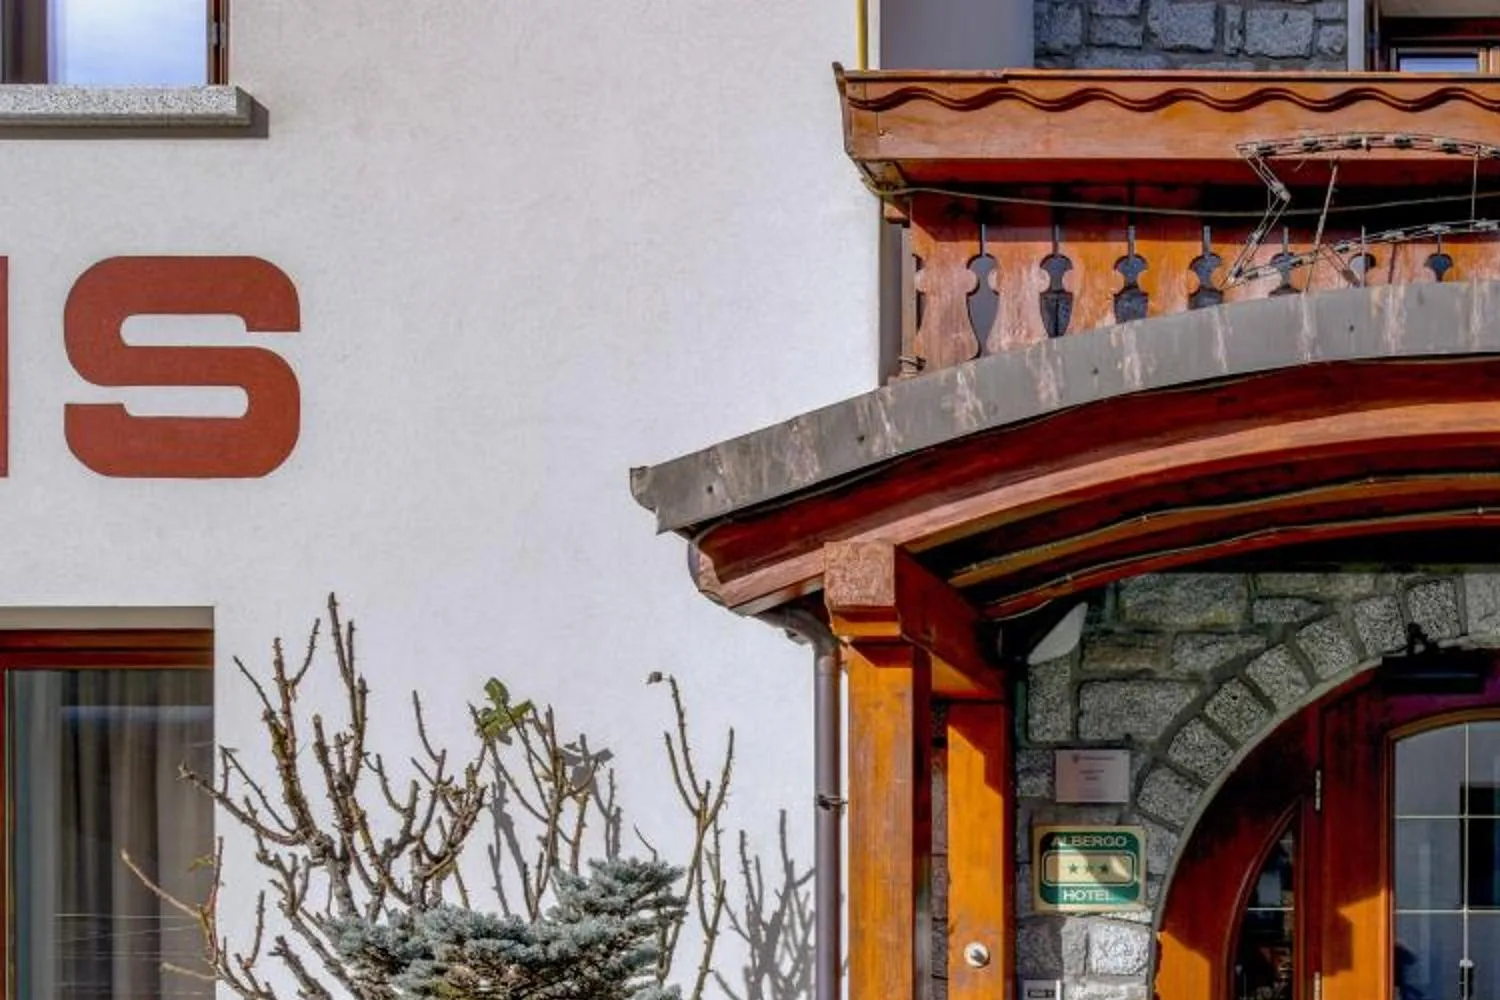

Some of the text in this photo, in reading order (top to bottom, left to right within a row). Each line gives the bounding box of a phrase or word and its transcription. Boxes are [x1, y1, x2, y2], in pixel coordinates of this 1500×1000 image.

[0, 256, 300, 478] S
[1051, 835, 1127, 848] ALBERGO
[1062, 888, 1116, 902] HOTEL
